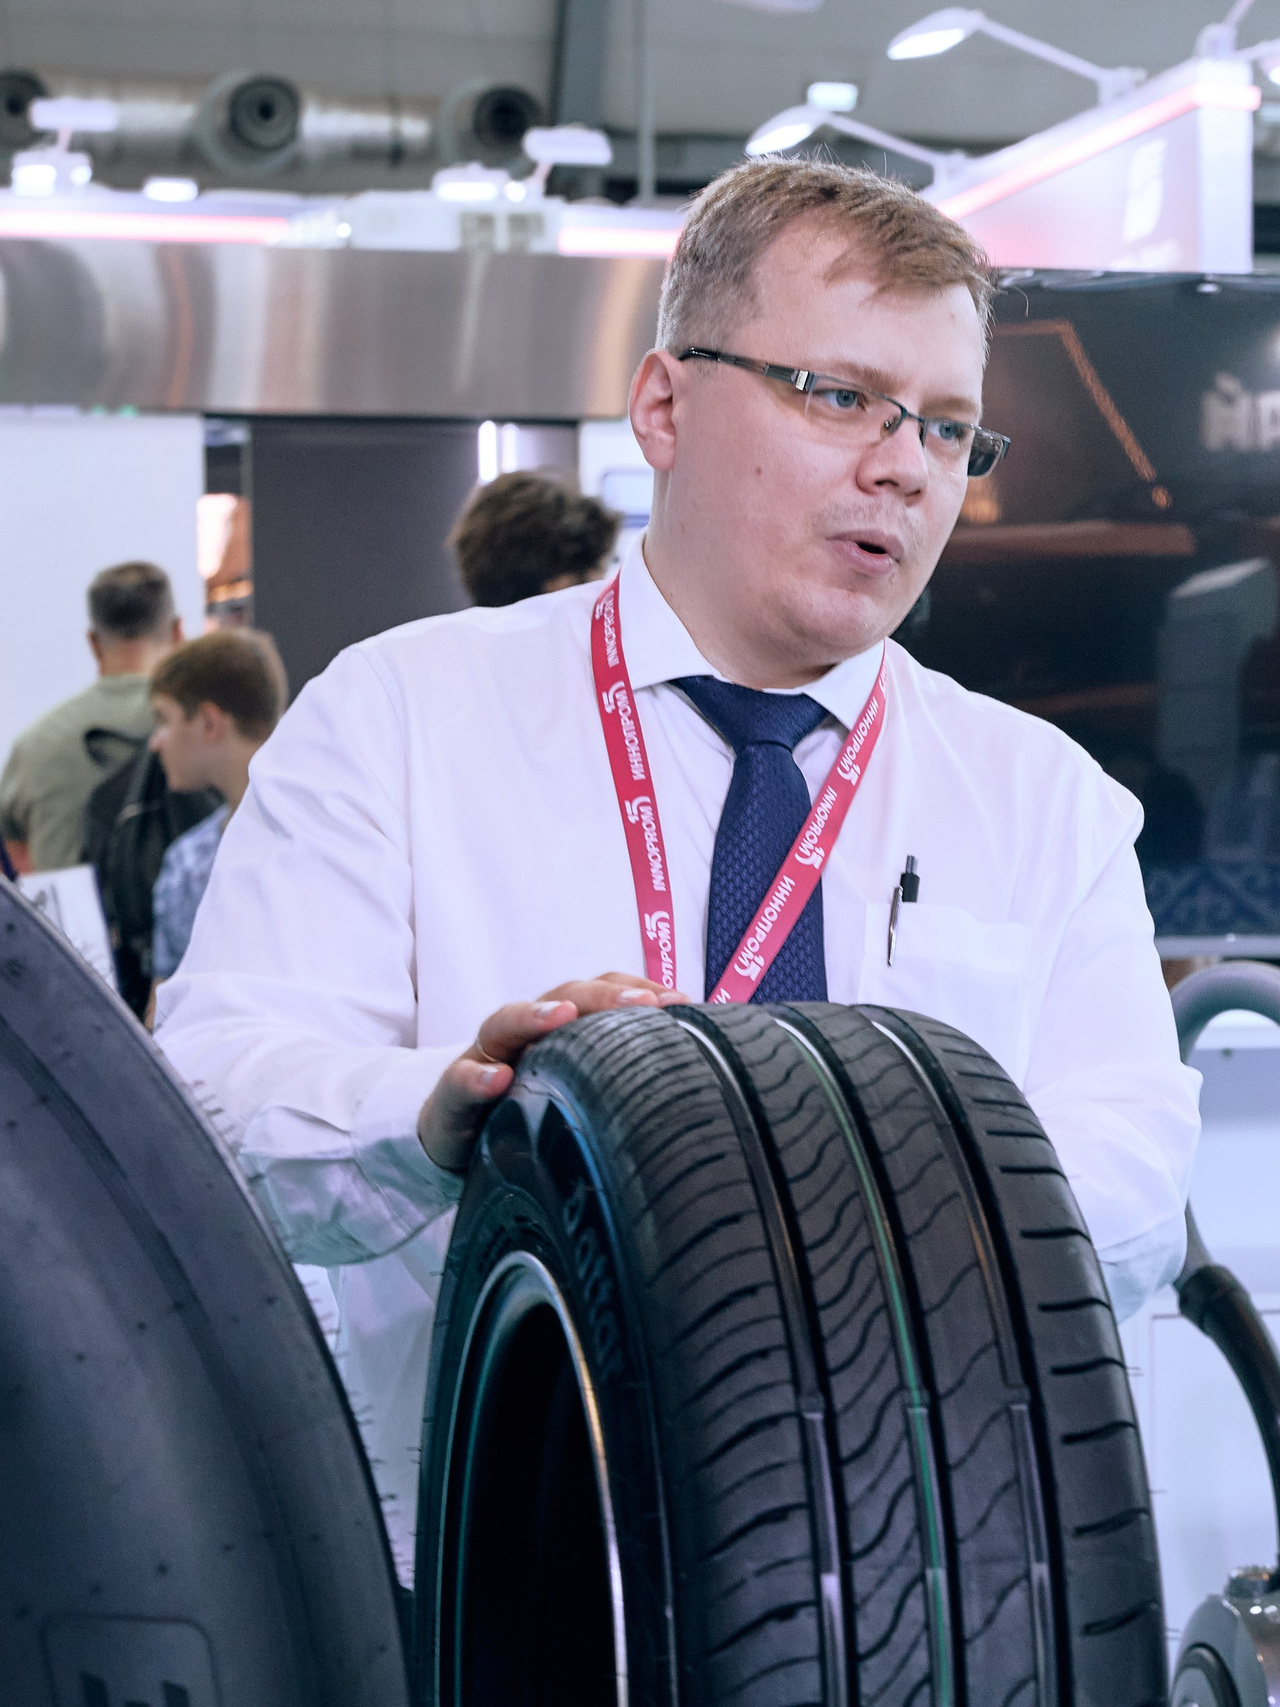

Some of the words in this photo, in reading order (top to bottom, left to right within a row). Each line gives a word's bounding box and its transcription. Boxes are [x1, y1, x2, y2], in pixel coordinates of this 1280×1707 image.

[604, 596, 620, 668] INNOPROM
[615, 689, 646, 780] ИННОПРОМ
[840, 696, 879, 772] ИННОПРОМ
[641, 805, 666, 892] INNOPROM
[799, 785, 838, 857] INNOPROM
[657, 918, 673, 989] ОПРОМ
[738, 875, 796, 968] ИННОПРОМ
